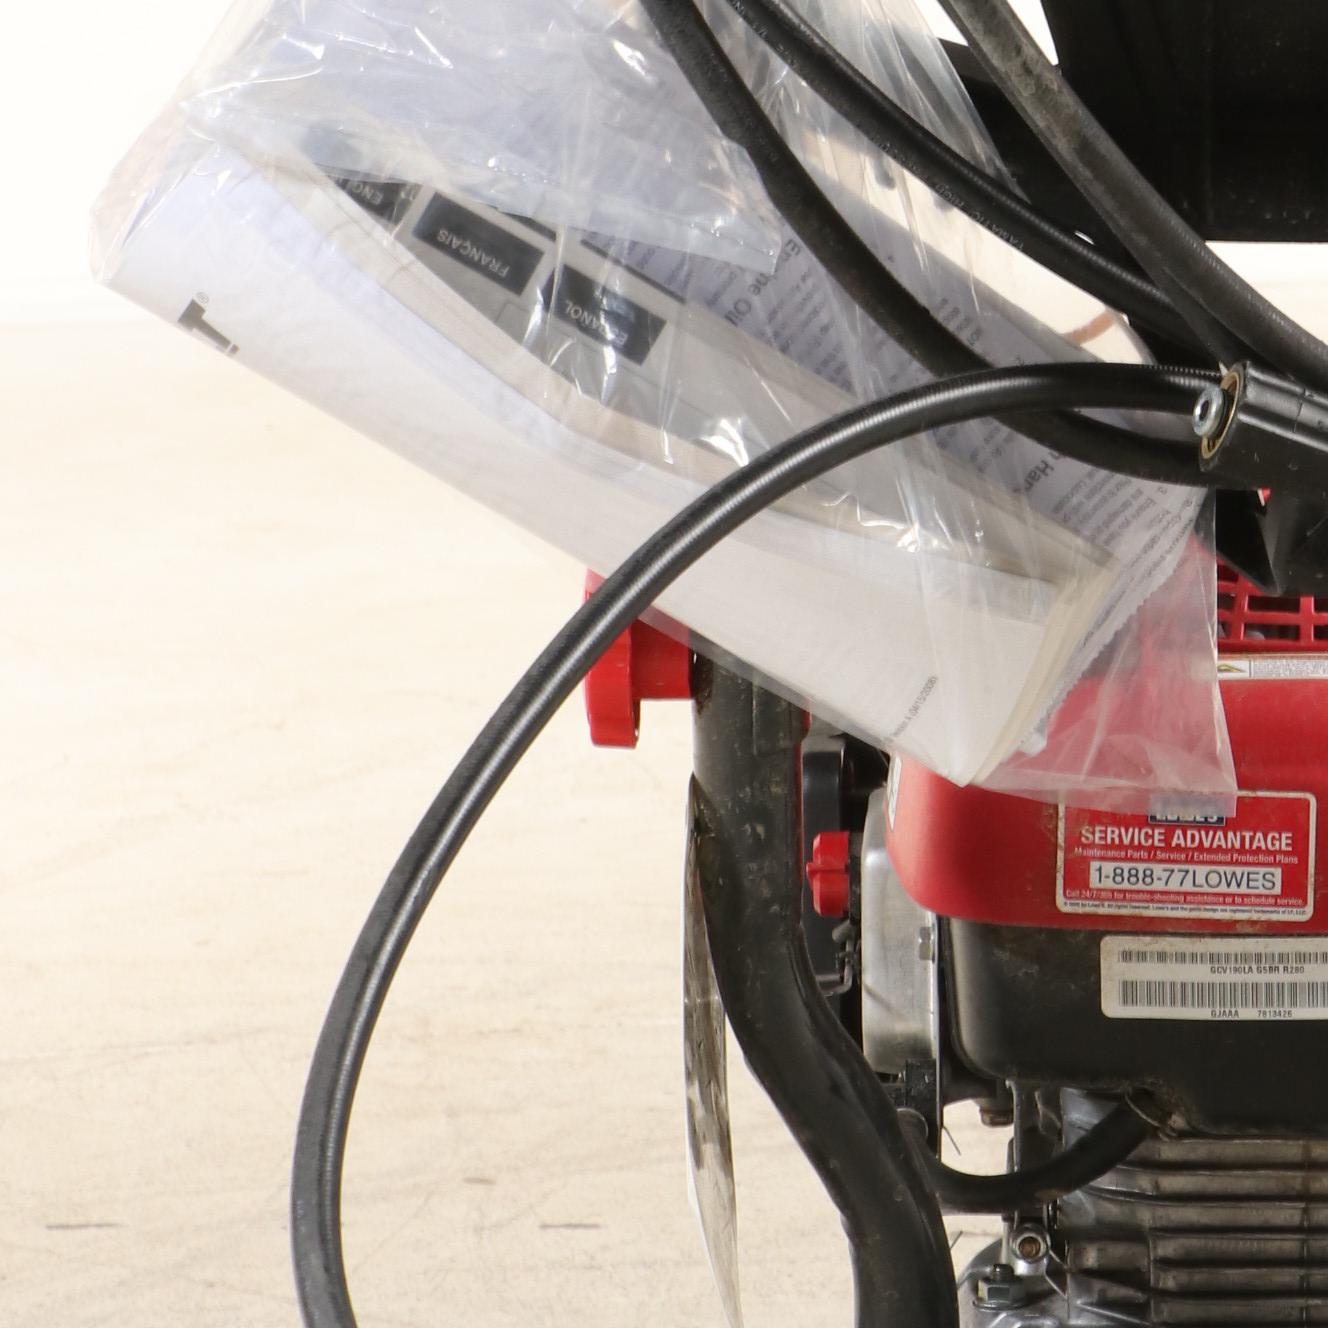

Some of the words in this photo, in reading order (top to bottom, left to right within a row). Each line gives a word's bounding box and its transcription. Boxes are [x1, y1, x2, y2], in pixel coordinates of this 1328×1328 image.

[437, 228, 510, 278] FRANÇAIS
[1081, 825, 1166, 847] SERVICE
[1171, 829, 1293, 852] ADVANTAGE
[1074, 847, 1126, 859] Maintenance
[1127, 849, 1148, 860] Parts
[1156, 850, 1186, 862] Service
[1193, 851, 1231, 863] Extended
[1232, 853, 1274, 864] Protection
[1275, 854, 1298, 865] Plans
[1094, 865, 1276, 890] 1-888-77LOWES
[1225, 896, 1233, 904] or
[1234, 895, 1242, 904] to
[1243, 895, 1275, 905] schedule
